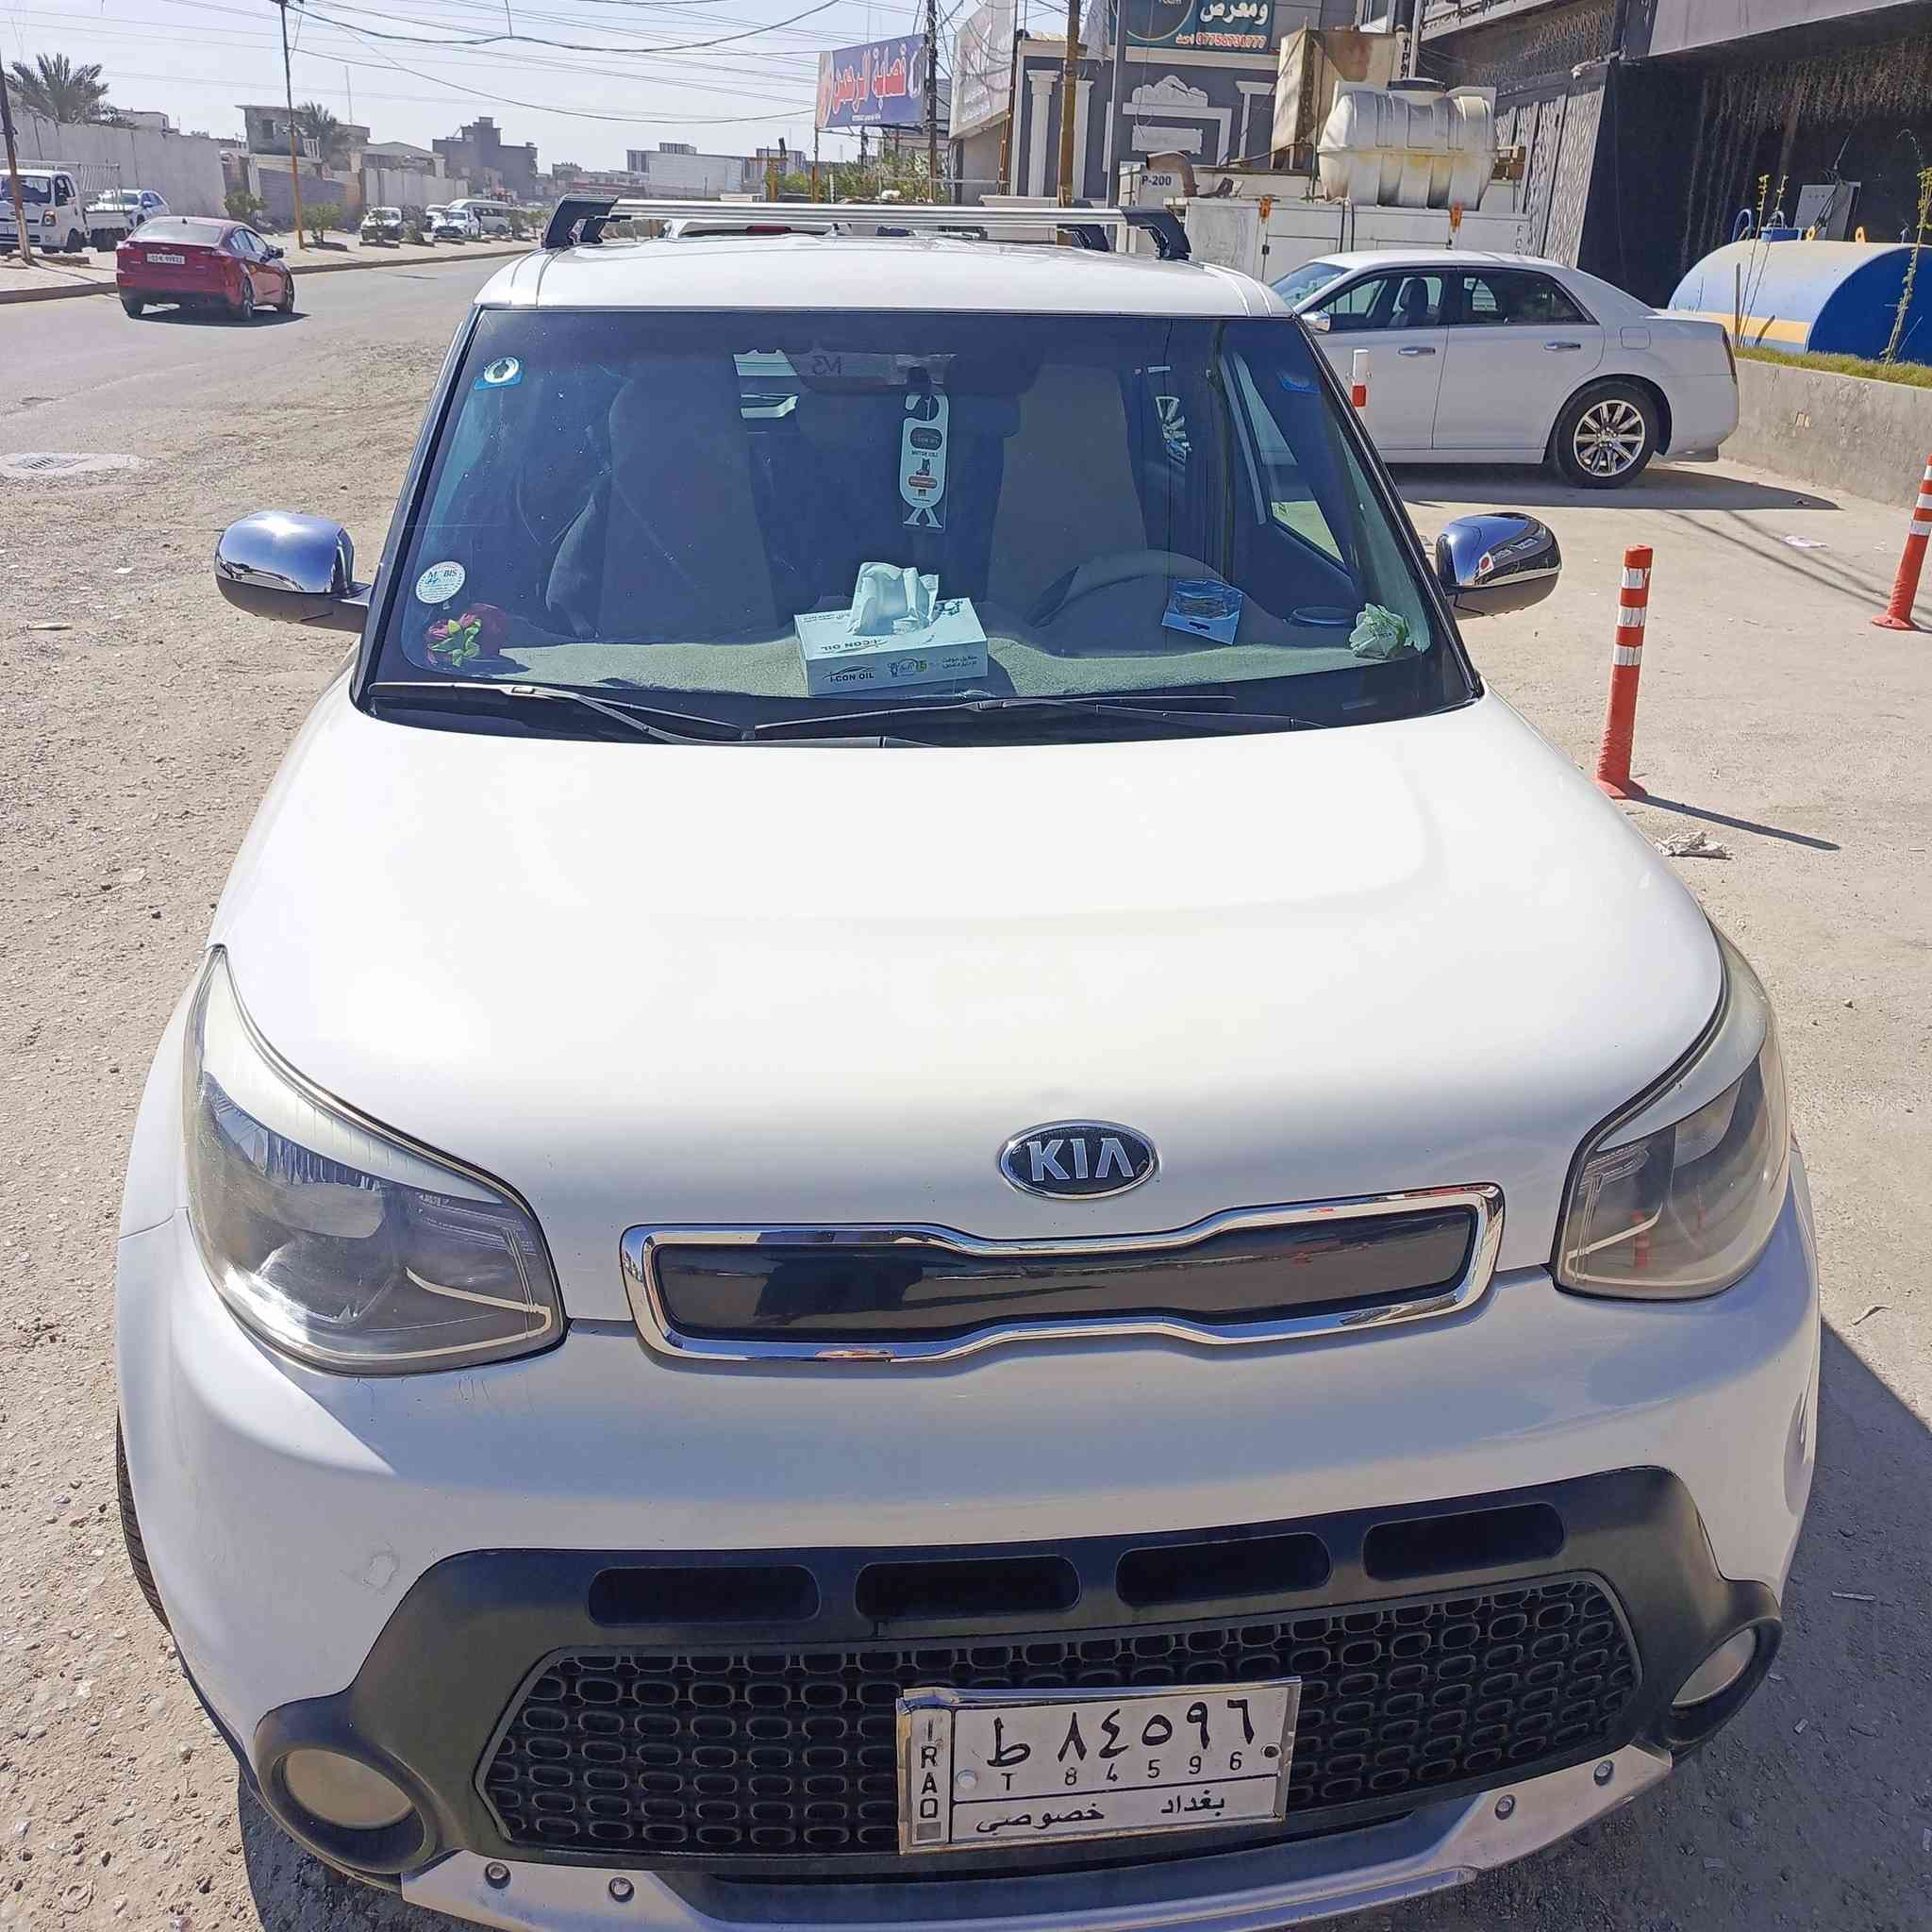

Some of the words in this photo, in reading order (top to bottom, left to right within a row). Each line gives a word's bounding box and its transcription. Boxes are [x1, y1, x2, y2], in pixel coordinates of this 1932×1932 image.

[1141, 175, 1172, 186] P-200
[858, 672, 874, 680] OIL
[1026, 1138, 1134, 1182] KIA
[986, 1716, 1031, 1767] ط
[1058, 1698, 1256, 1763] ٨٤٥٩٦
[919, 1718, 939, 1820] IRAQ
[1001, 1773, 1016, 1791] T
[1063, 1751, 1242, 1787] 84596
[975, 1802, 1105, 1834] خصوصي
[1160, 1789, 1225, 1817] بغداد
